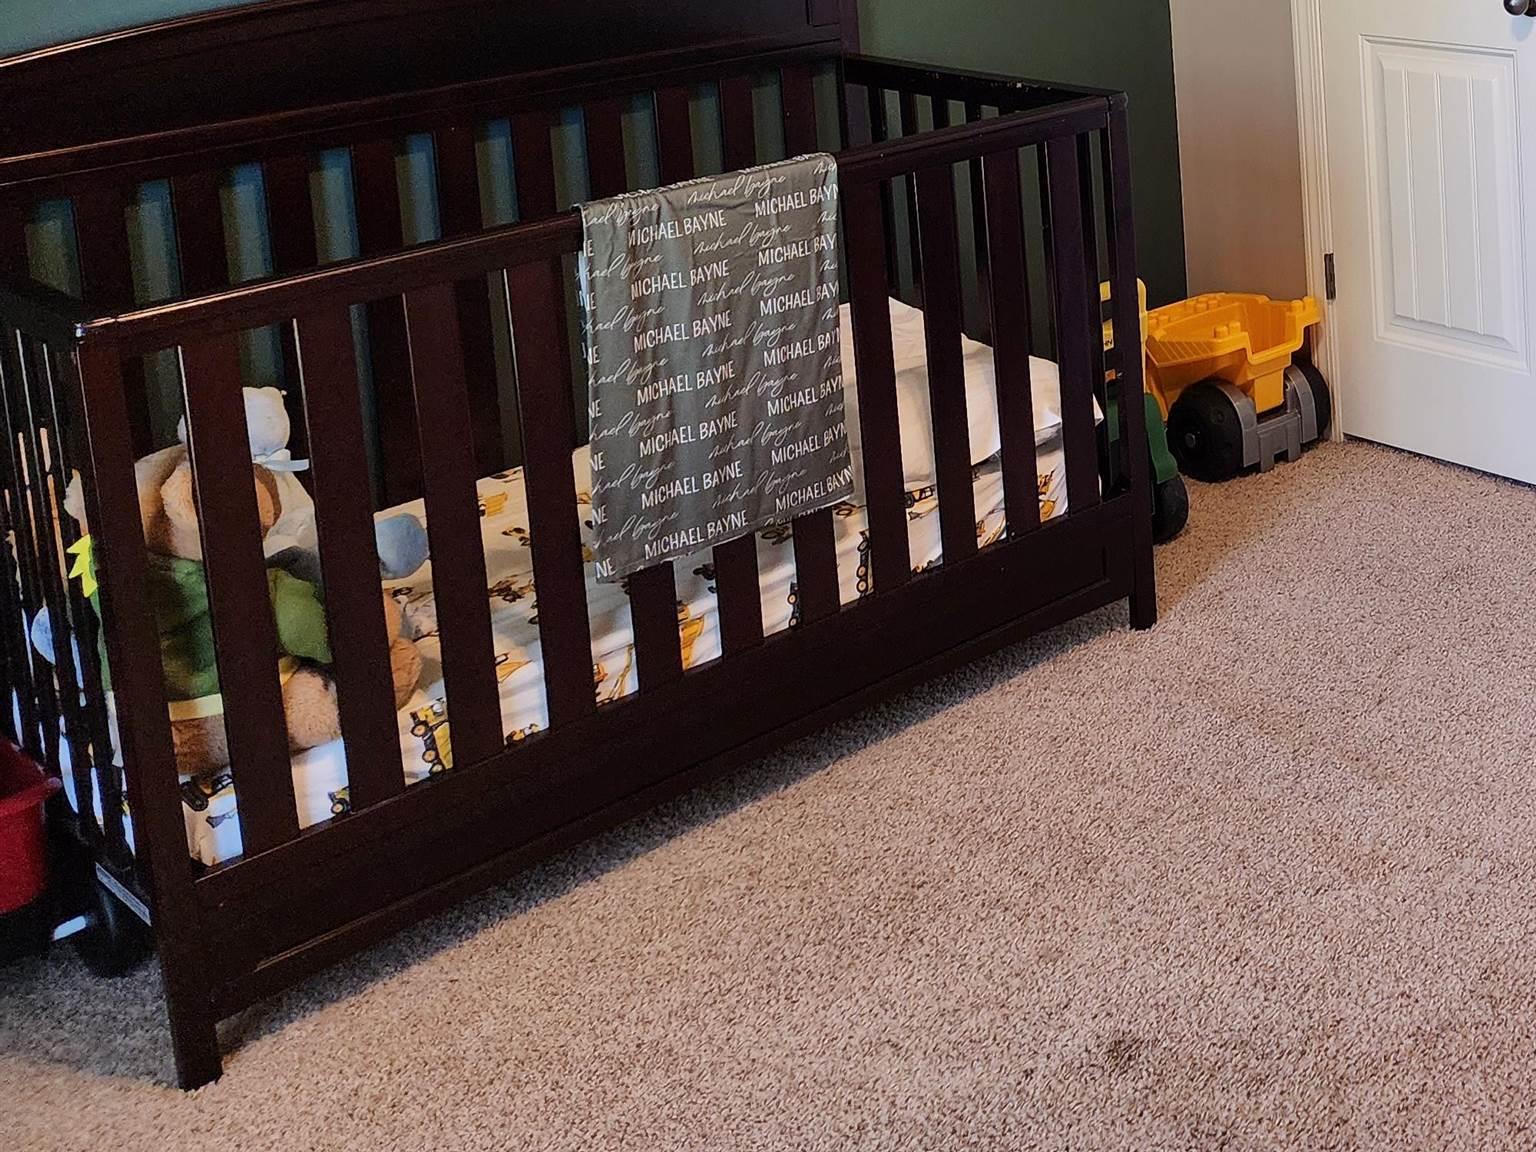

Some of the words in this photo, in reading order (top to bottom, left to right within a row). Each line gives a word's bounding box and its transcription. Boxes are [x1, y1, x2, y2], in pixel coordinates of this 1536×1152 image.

[755, 192, 807, 218] MICHAEL
[809, 184, 838, 205] BAYN
[684, 210, 727, 235] BAYNE
[690, 259, 729, 286] BAYNE
[758, 240, 811, 267] MICHAEL
[760, 289, 814, 317] MICHAEL
[634, 324, 689, 353] MICHAEL
[693, 310, 732, 338] BAYNE
[763, 339, 815, 367] MICHAEL
[637, 375, 693, 406] MICHAEL
[696, 360, 736, 389] BAYNE
[767, 387, 818, 417] MICHAEL
[640, 425, 696, 458] MICHAEL
[700, 411, 738, 439] BAYNE
[771, 435, 821, 466] MICHAEL
[823, 422, 847, 448] BAYN
[641, 476, 700, 510] MICHAEL
[703, 460, 743, 490] BAYNE
[775, 481, 827, 514] MICHAEL
[826, 465, 854, 492] BAYN
[644, 527, 704, 560] MICHAEL
[707, 510, 749, 539] BAYNE
